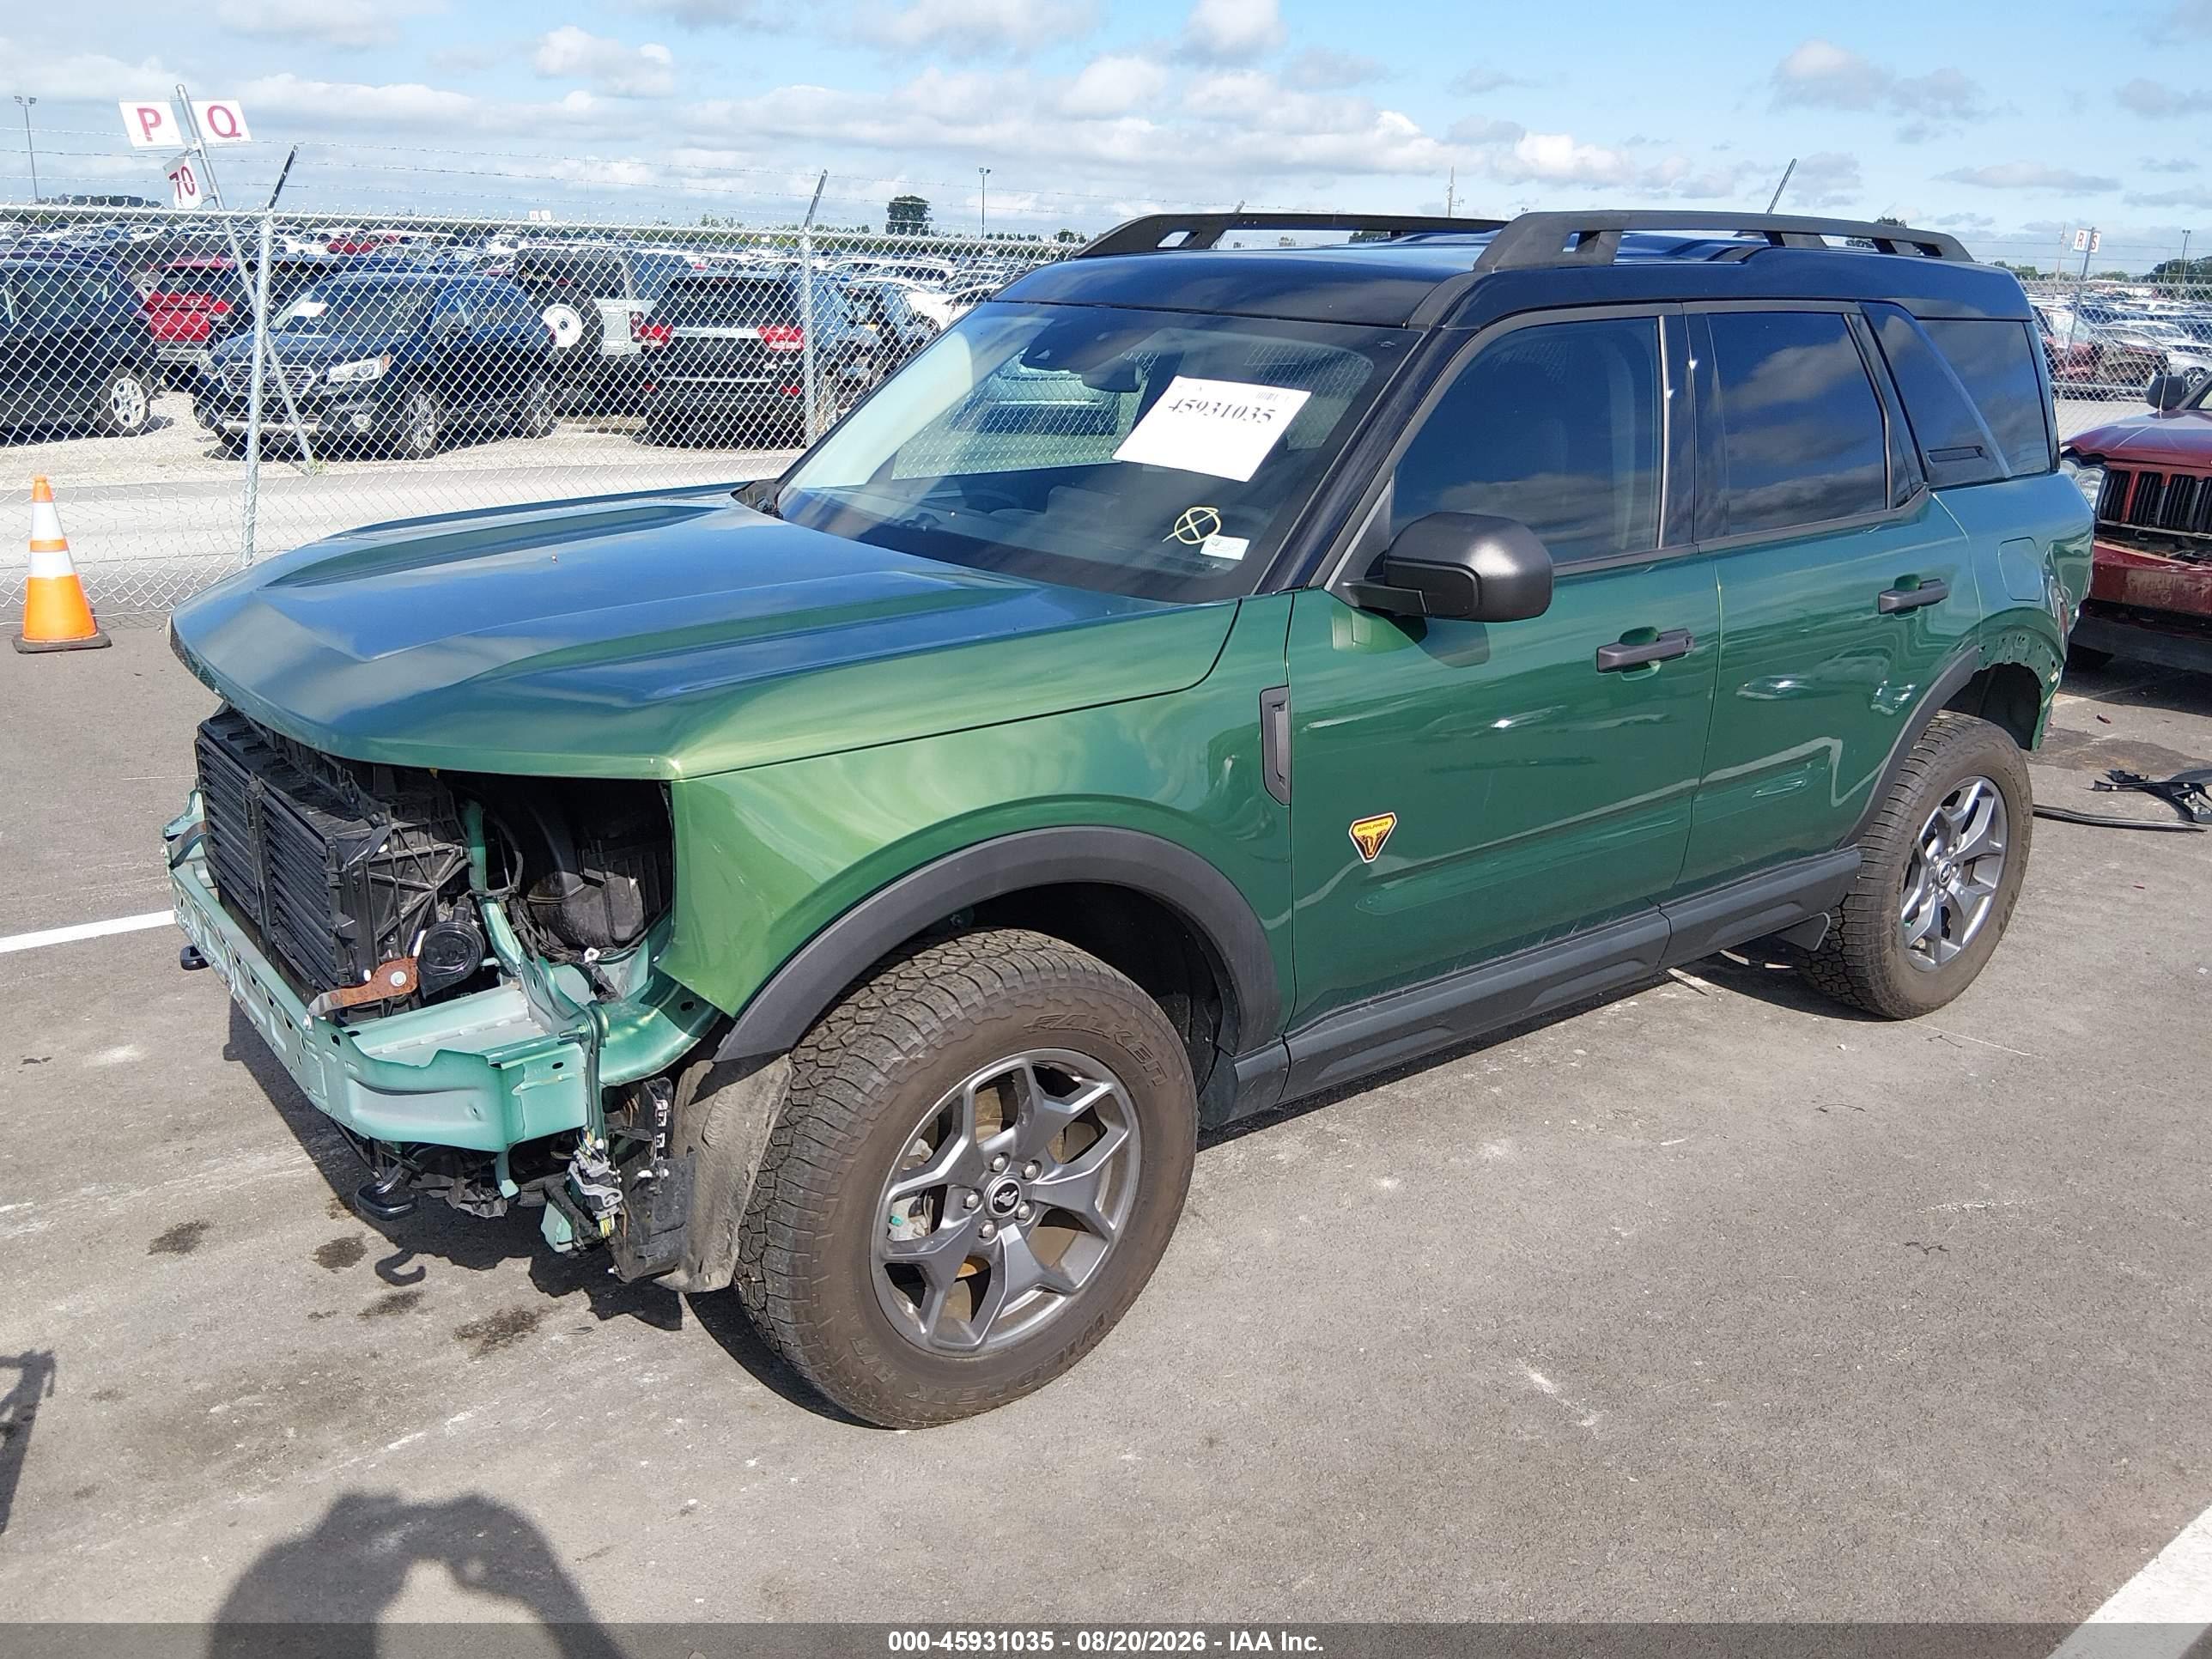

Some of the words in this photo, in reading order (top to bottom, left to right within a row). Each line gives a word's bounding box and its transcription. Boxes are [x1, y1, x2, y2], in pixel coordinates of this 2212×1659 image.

[137, 107, 162, 142] P
[207, 105, 241, 138] Q
[168, 166, 196, 202] 70
[2077, 232, 2084, 248] R
[1168, 398, 1277, 423] 45931035
